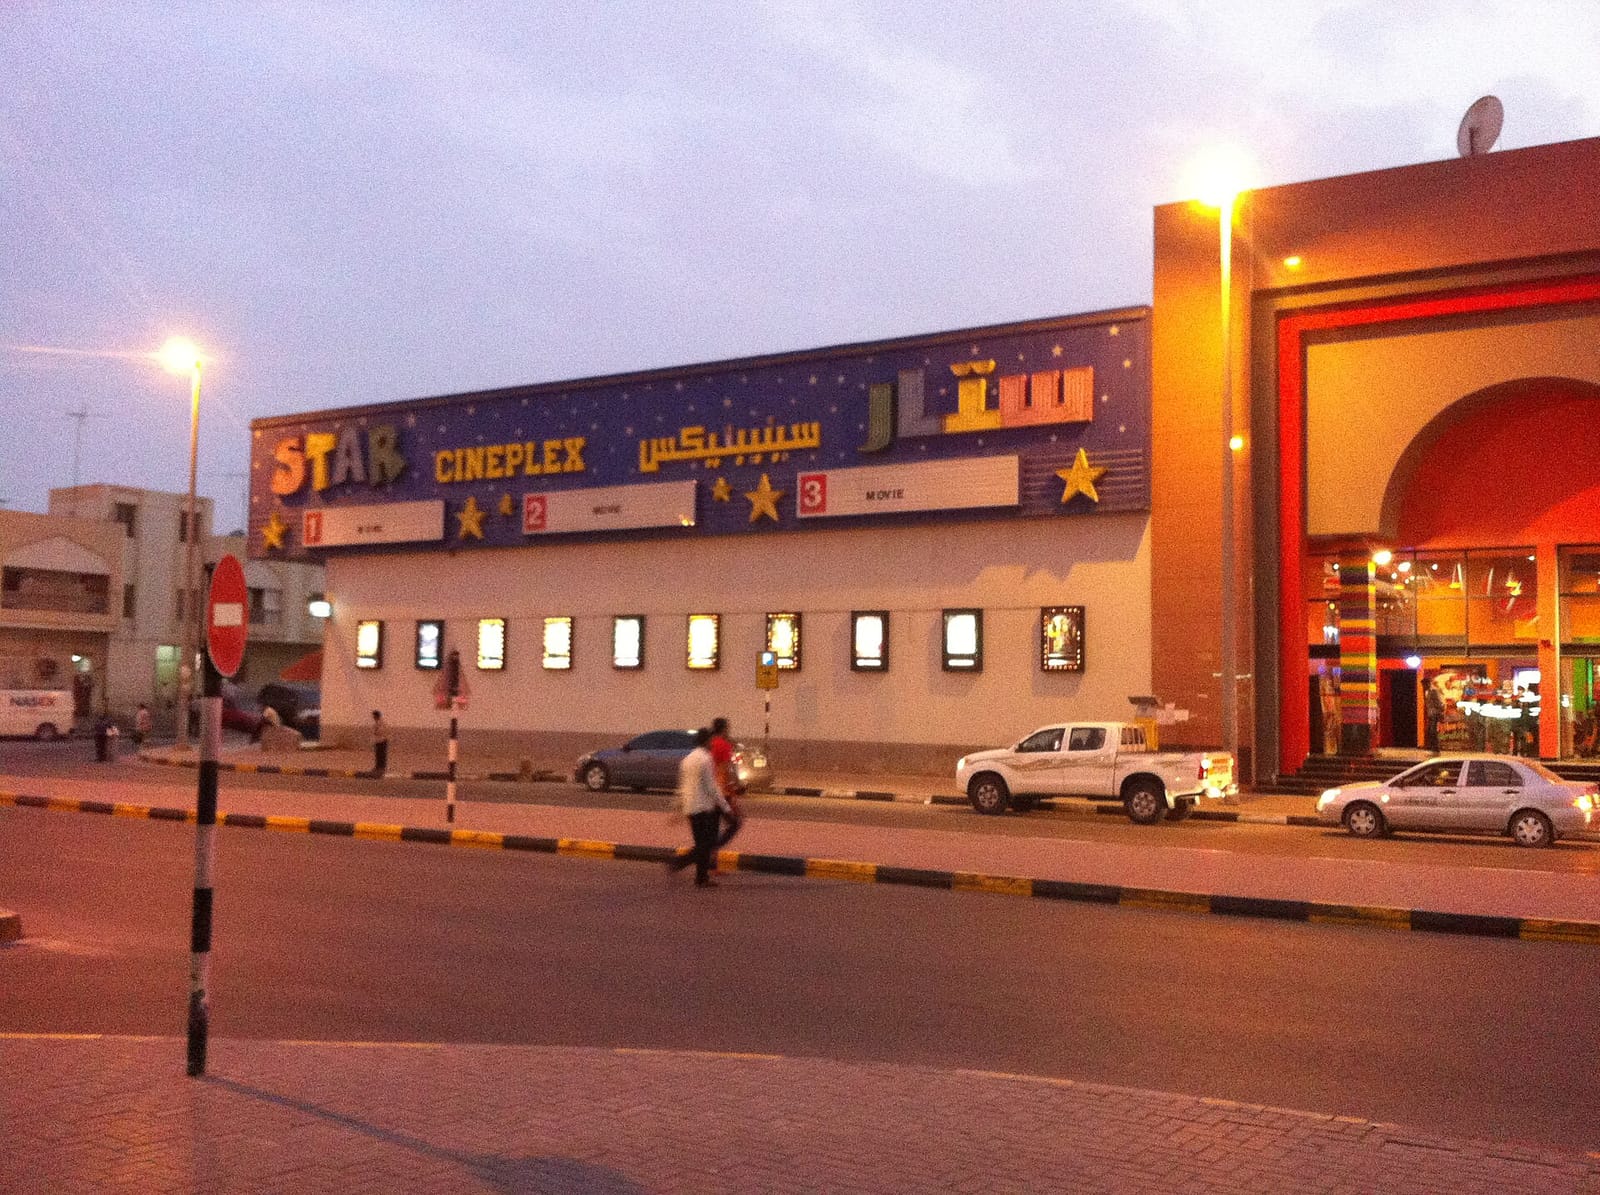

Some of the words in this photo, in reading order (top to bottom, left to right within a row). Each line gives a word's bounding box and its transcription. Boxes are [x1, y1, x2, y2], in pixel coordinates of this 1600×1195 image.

[858, 359, 1094, 452] ستار
[271, 425, 405, 495] STAR
[435, 436, 587, 484] CINEPLEX
[527, 501, 542, 525] 2
[803, 480, 822, 508] 3
[865, 488, 905, 501] MOVIE
